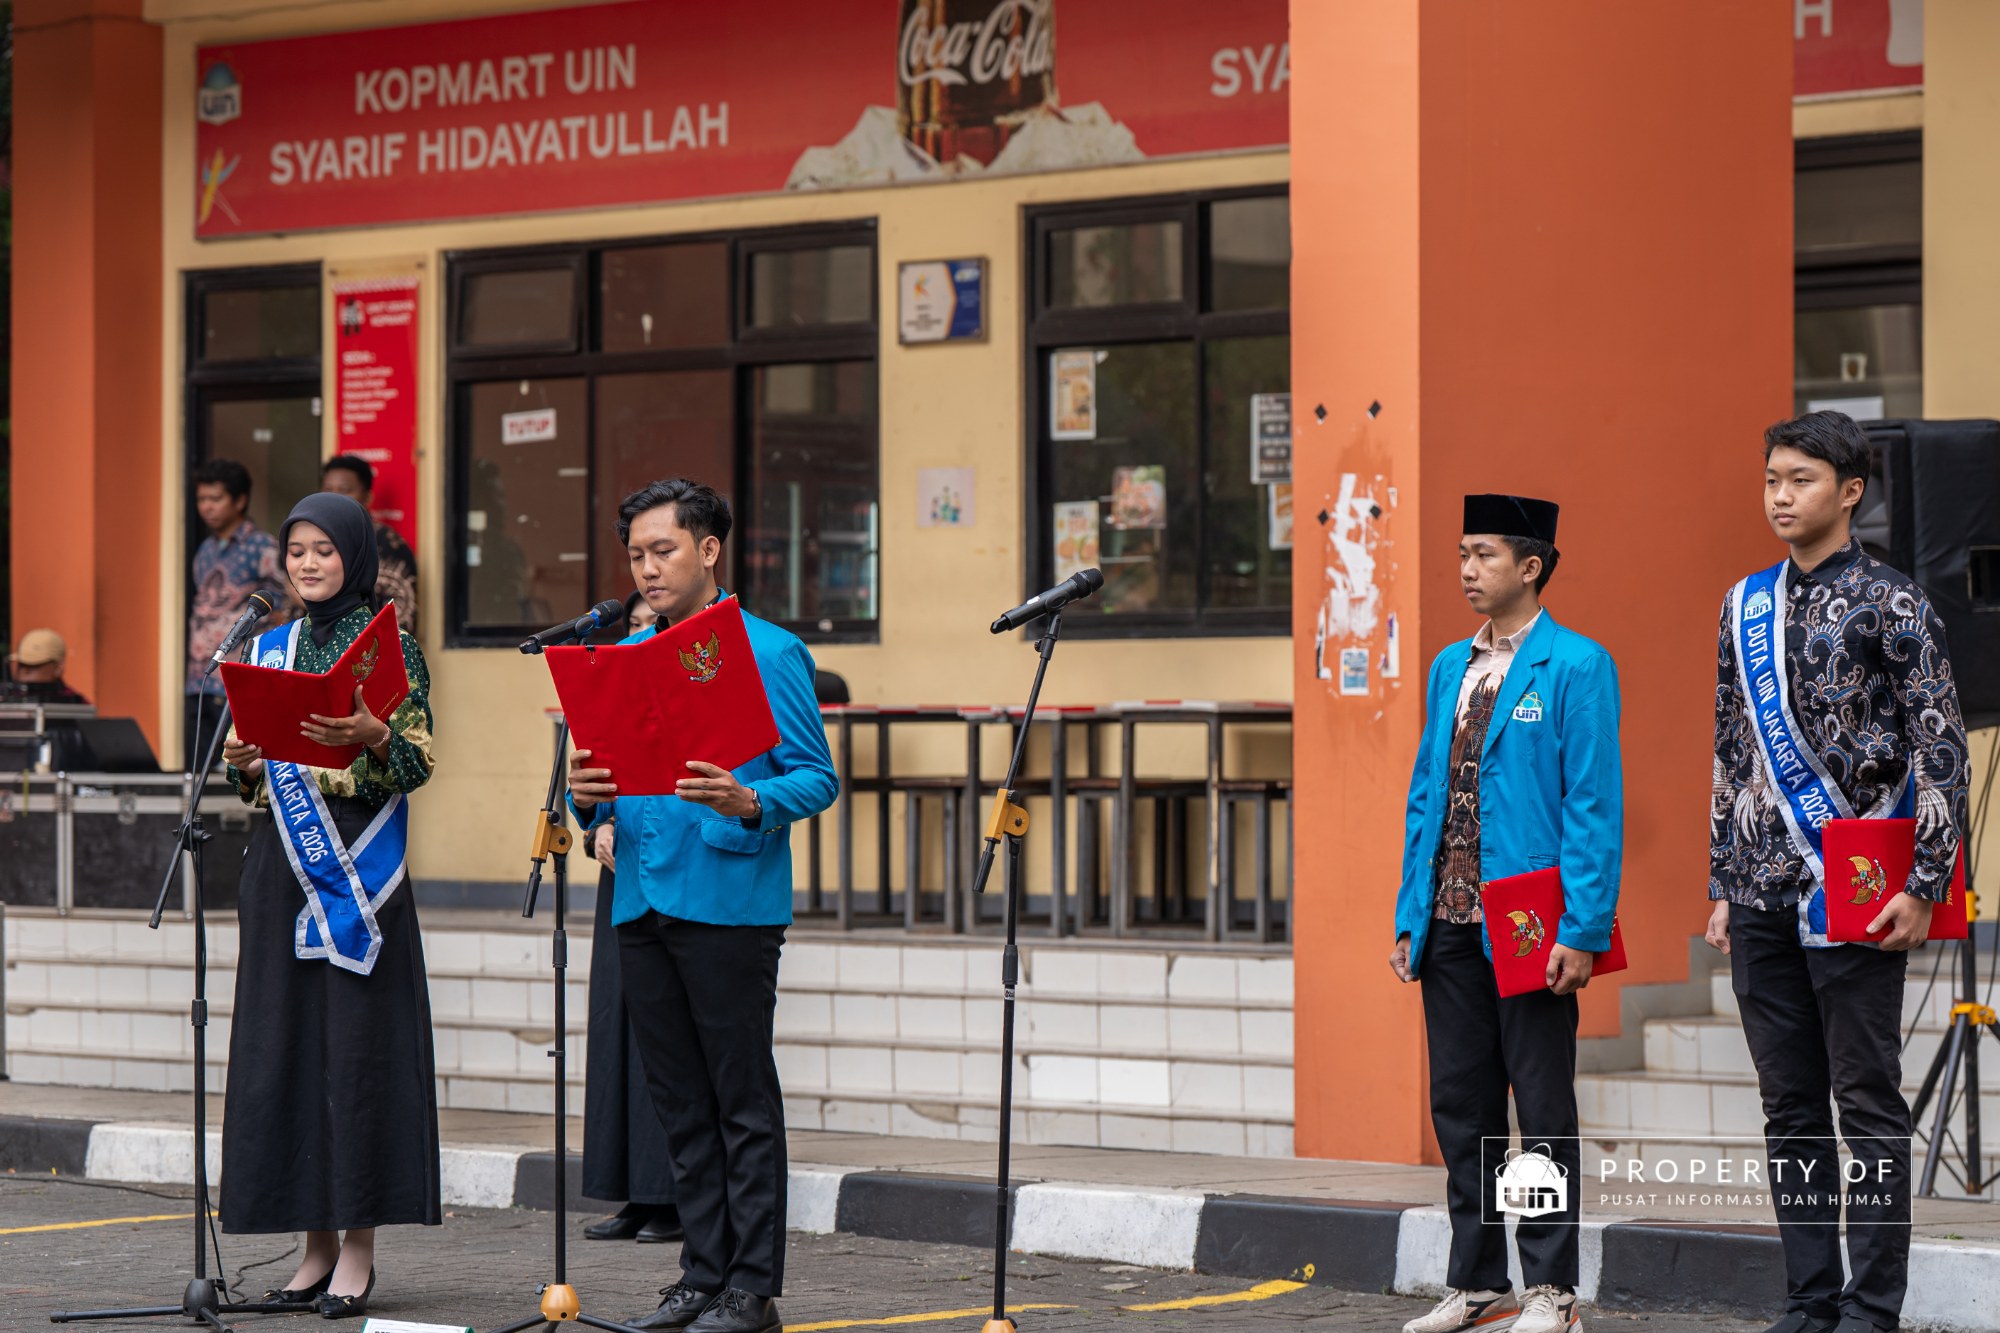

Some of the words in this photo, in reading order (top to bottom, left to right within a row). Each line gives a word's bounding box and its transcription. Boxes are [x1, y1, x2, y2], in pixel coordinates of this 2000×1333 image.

[355, 53, 554, 114] KOPMART
[564, 45, 636, 92] UIN
[269, 133, 407, 185] SYARIF
[418, 103, 730, 172] HIDAYATULLAH
[1747, 623, 1768, 671] DUTA
[1755, 671, 1777, 705] UIN
[1762, 709, 1809, 790] JAKARTA
[272, 760, 311, 826] AKARTA
[299, 826, 328, 863] 2026
[1798, 787, 1833, 828] 2026
